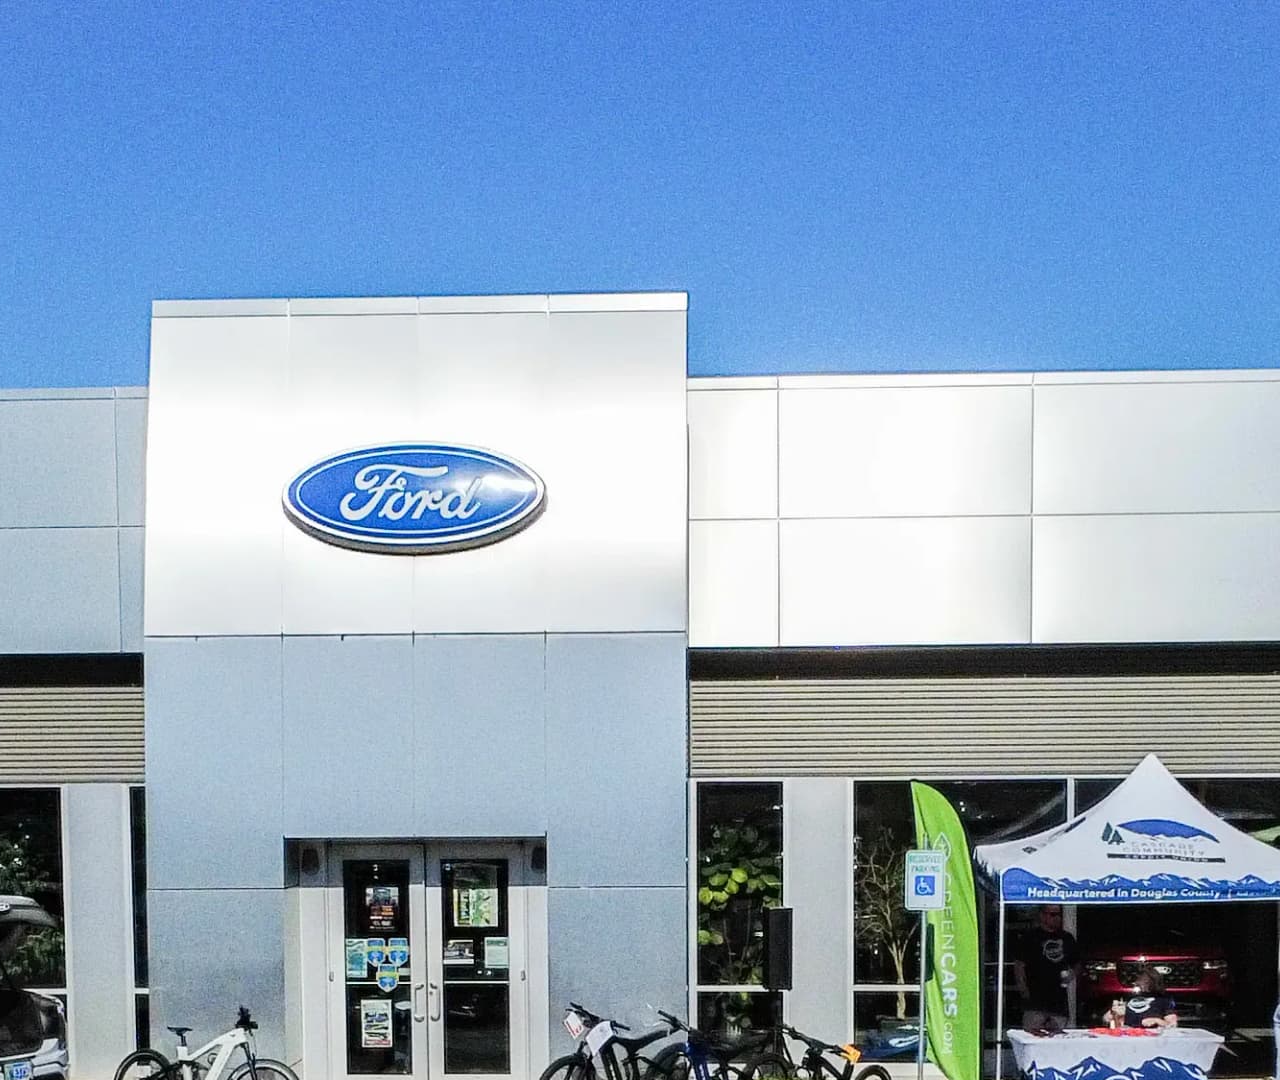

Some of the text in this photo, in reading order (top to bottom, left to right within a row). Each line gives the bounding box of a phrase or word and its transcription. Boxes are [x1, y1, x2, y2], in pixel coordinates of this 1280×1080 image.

[339, 462, 482, 521] Ford
[1027, 886, 1115, 899] Headquartered
[1117, 887, 1129, 897] in
[1130, 887, 1178, 899] Douglas
